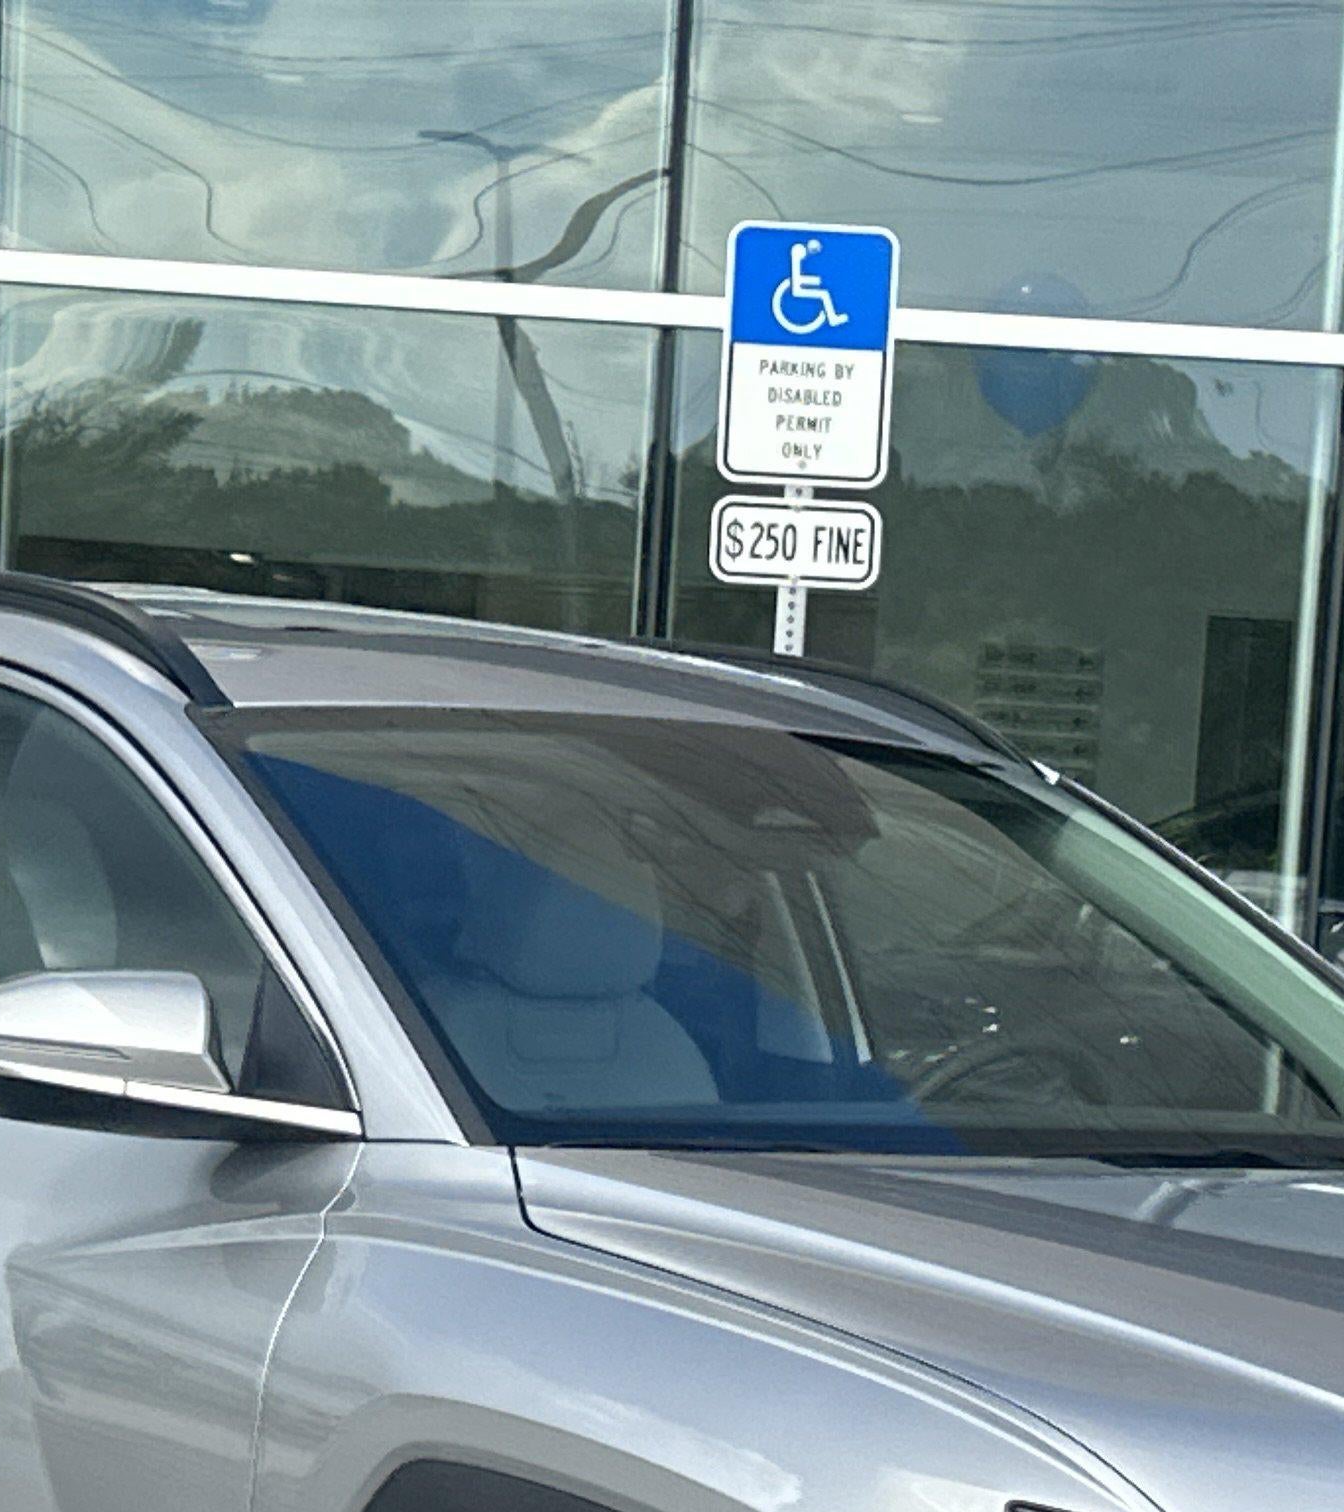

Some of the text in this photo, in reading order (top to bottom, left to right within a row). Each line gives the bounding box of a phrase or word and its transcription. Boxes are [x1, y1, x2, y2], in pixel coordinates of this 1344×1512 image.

[759, 359, 855, 380] PARKING BY
[767, 386, 843, 407] DISABLED
[775, 414, 833, 433] PERMIT
[781, 441, 823, 460] ONLY
[725, 518, 866, 564] $250 FINE
